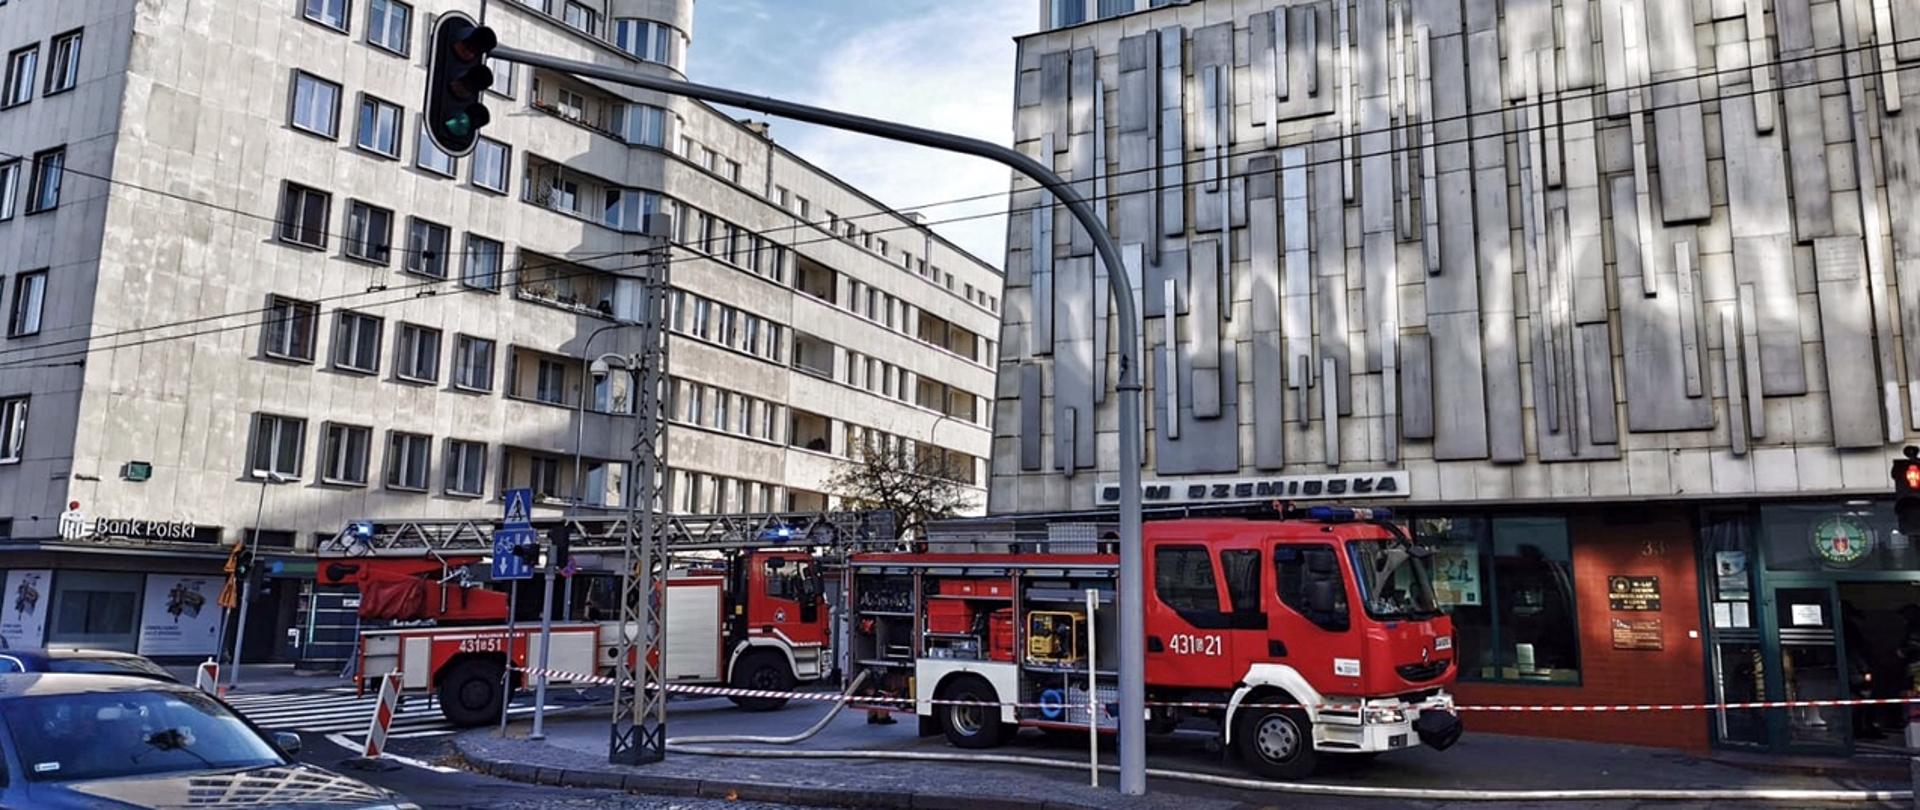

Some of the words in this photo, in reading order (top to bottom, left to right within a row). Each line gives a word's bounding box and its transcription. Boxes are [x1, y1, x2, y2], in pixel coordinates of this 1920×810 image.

[1103, 485, 1171, 501] DM
[97, 517, 141, 536] Bank
[146, 519, 196, 539] Polski
